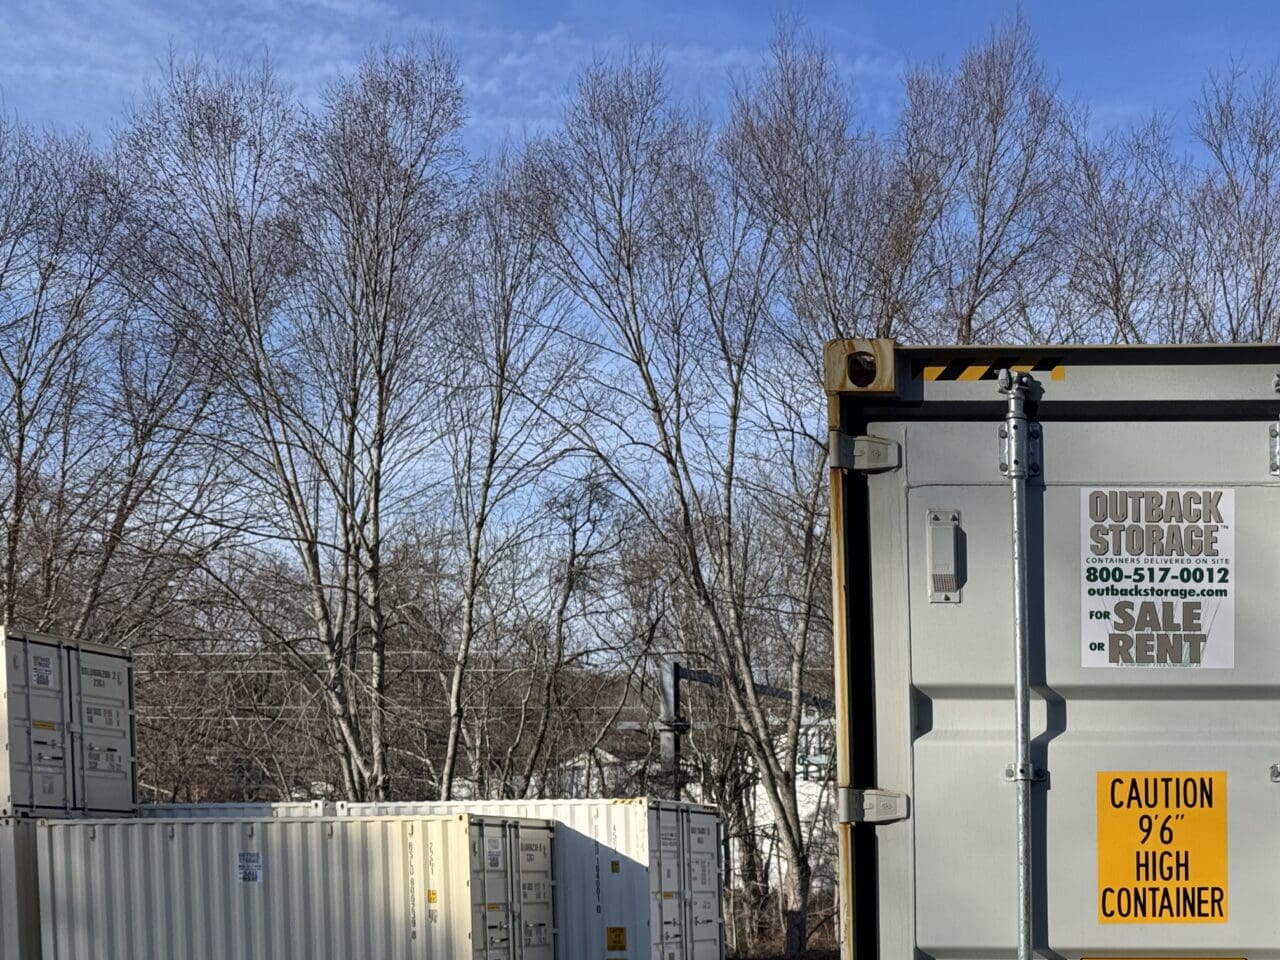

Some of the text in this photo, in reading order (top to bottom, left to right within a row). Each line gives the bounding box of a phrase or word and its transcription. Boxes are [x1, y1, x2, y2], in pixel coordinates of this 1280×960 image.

[1089, 490, 1224, 523] OUTBACK
[1089, 524, 1220, 557] STORAGE
[1086, 567, 1230, 583] 800-517-0012
[1087, 585, 1228, 599] outbackstorage.com
[1089, 600, 1202, 632] FOR SALE
[1089, 633, 1206, 663] OR RENT
[1110, 777, 1213, 808] CAUTION
[1135, 851, 1189, 881] HIGH
[1101, 887, 1224, 918] CONTAINER
